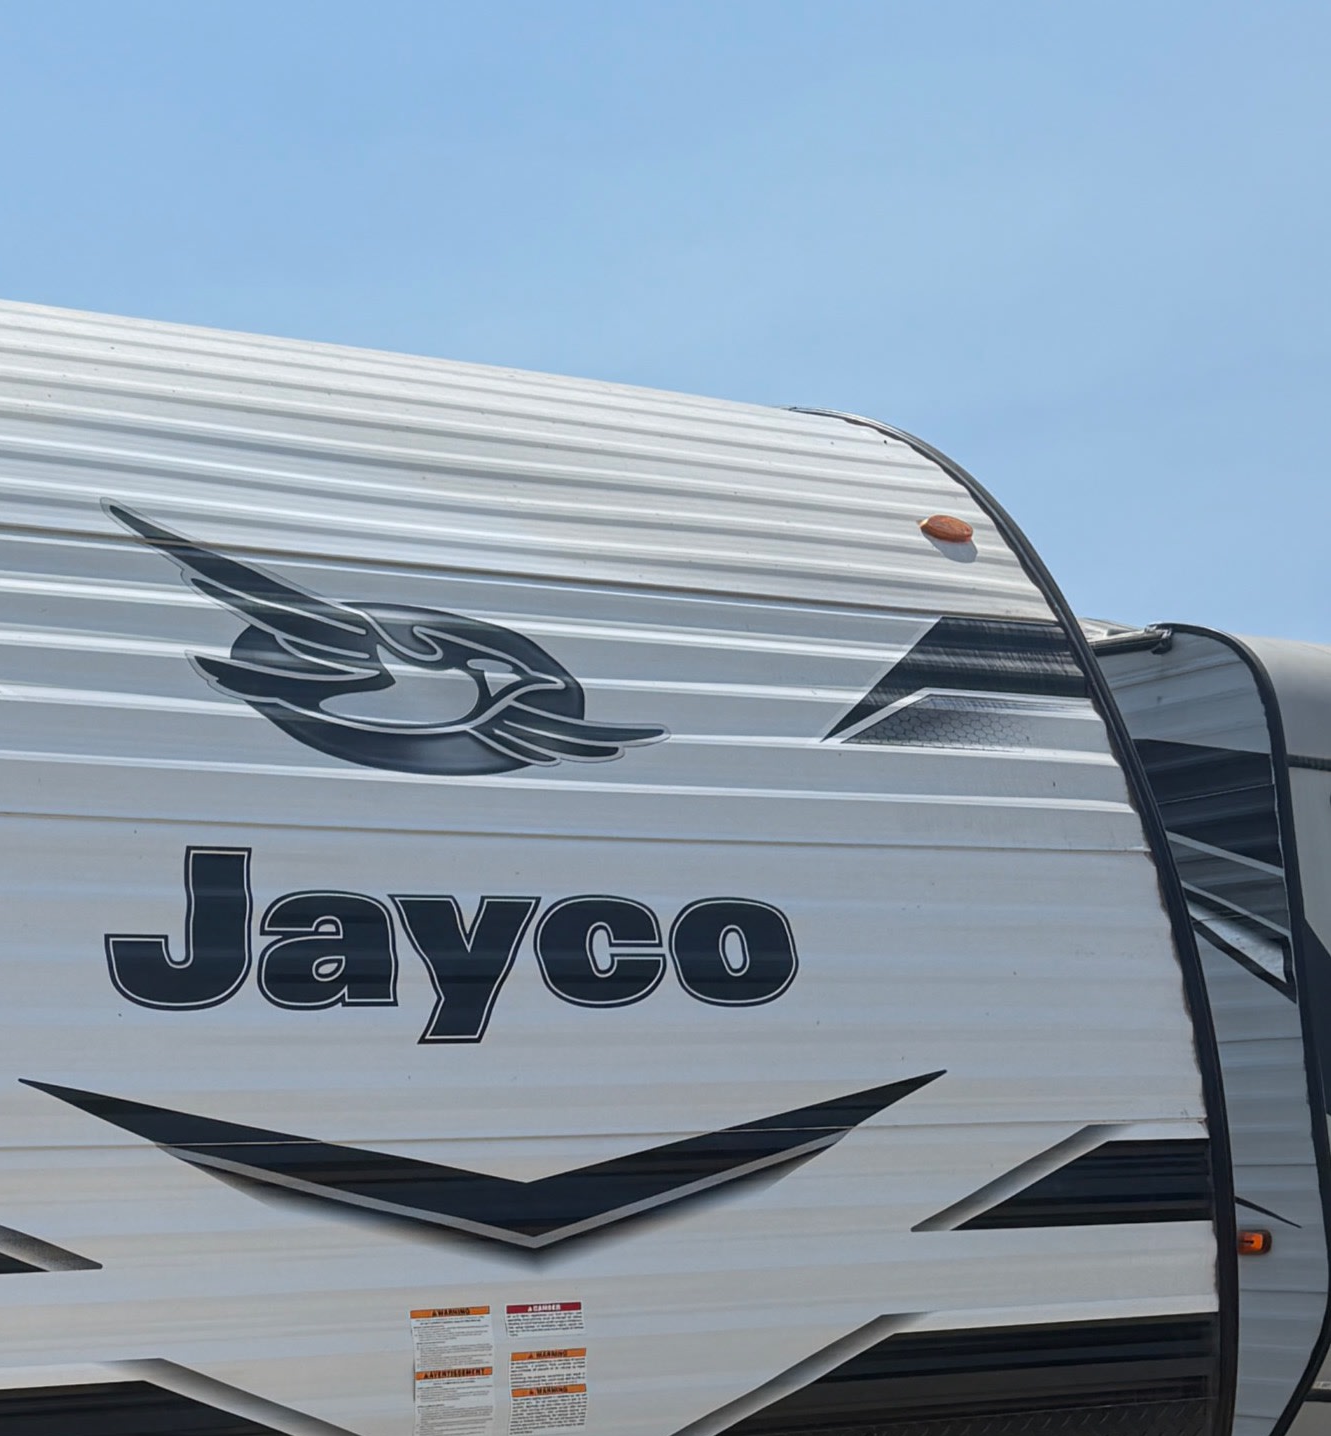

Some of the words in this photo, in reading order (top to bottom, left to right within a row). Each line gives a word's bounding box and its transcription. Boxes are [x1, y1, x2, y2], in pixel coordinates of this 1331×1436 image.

[104, 846, 799, 1044] Jayco
[437, 1307, 471, 1317] WARNING
[533, 1303, 561, 1312] DANGER
[536, 1350, 568, 1359] WARNING
[429, 1367, 484, 1379] AVERTISSEMENT
[536, 1385, 568, 1395] WARNING
